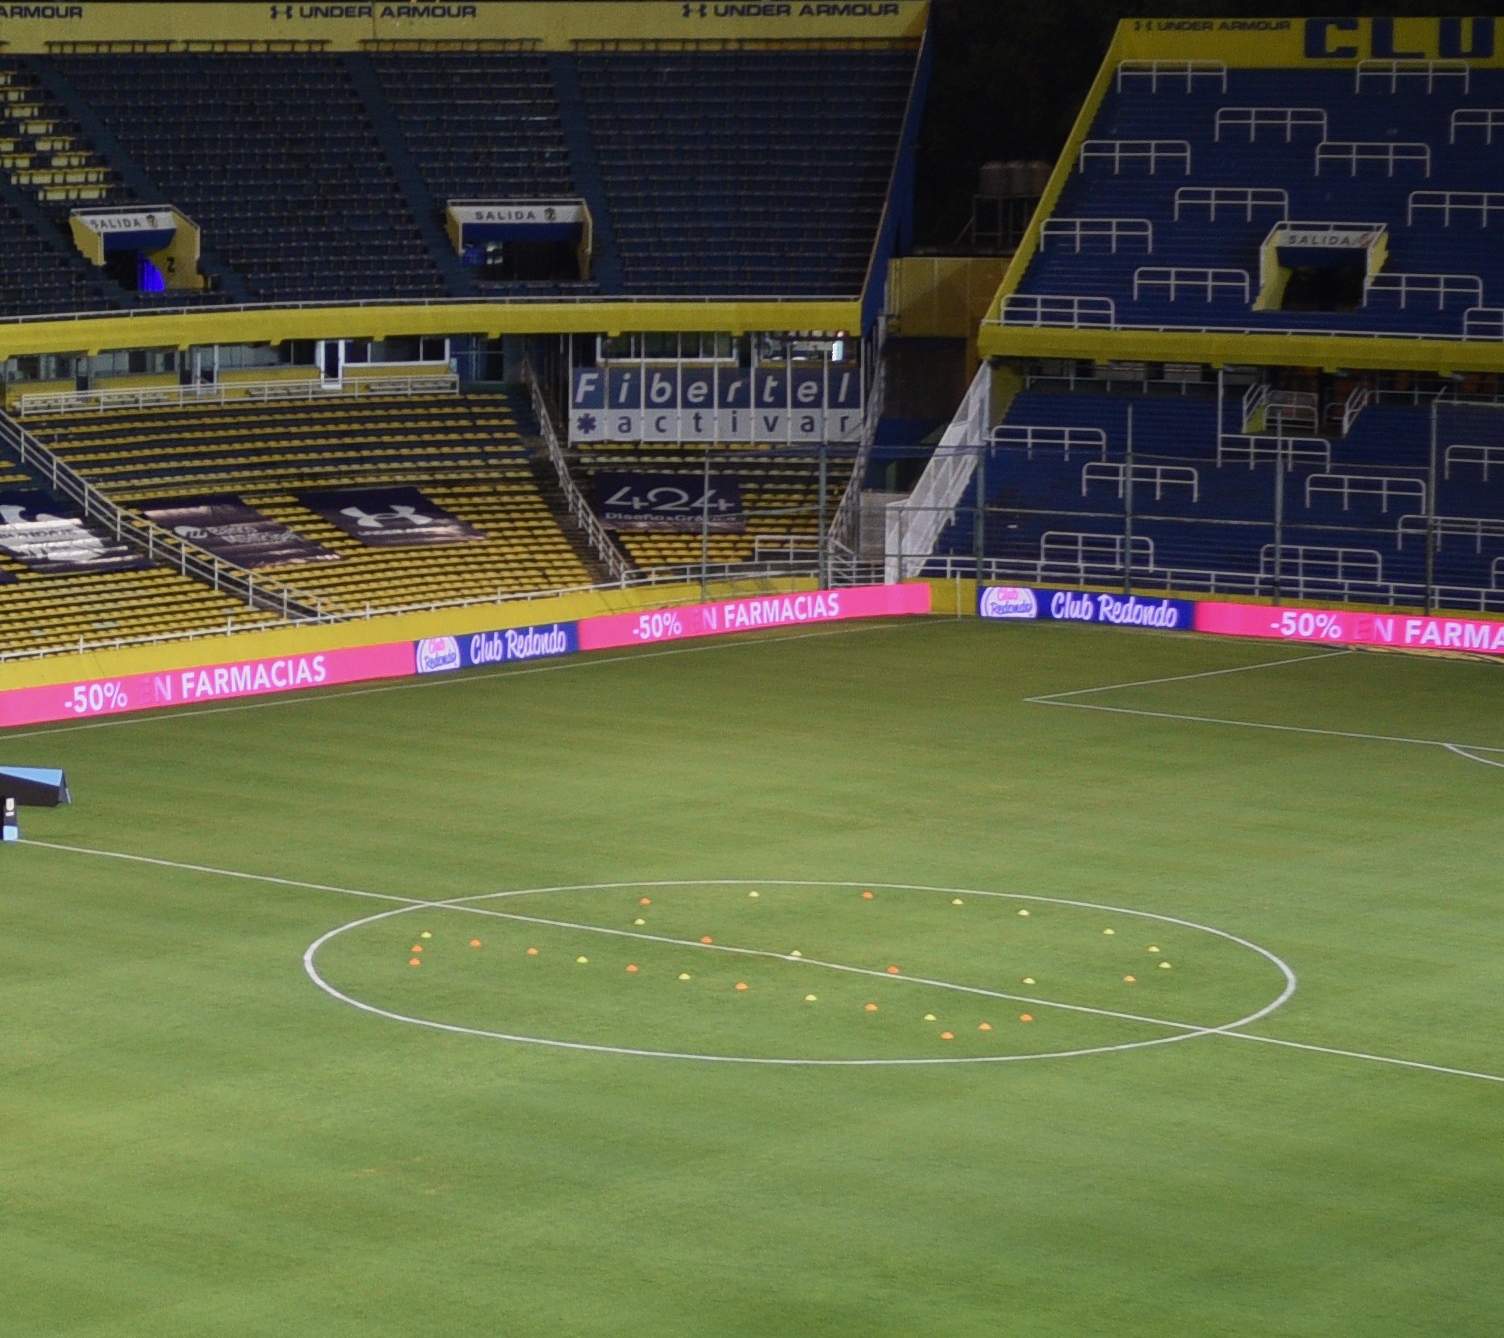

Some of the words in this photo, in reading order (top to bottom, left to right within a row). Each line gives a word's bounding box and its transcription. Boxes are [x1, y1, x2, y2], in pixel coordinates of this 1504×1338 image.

[299, 5, 373, 18] UNDER
[379, 5, 477, 18] ARMOUR
[714, 3, 792, 17] UNDER
[799, 3, 900, 17] ARMOUR
[475, 210, 536, 222] SALIDA
[1290, 235, 1351, 245] SALIDA
[575, 372, 851, 404] Fibertel
[618, 411, 849, 434] activar
[605, 486, 734, 512] 424
[633, 611, 683, 640] -50%
[724, 592, 841, 629] FARMACIAS
[1051, 591, 1092, 620] Club
[1097, 593, 1178, 627] Redondo
[1271, 612, 1342, 641] -50%
[470, 633, 503, 665] Club
[505, 623, 567, 660] Redondo
[65, 682, 127, 714] -50%
[181, 655, 326, 700] FARMACIAS
